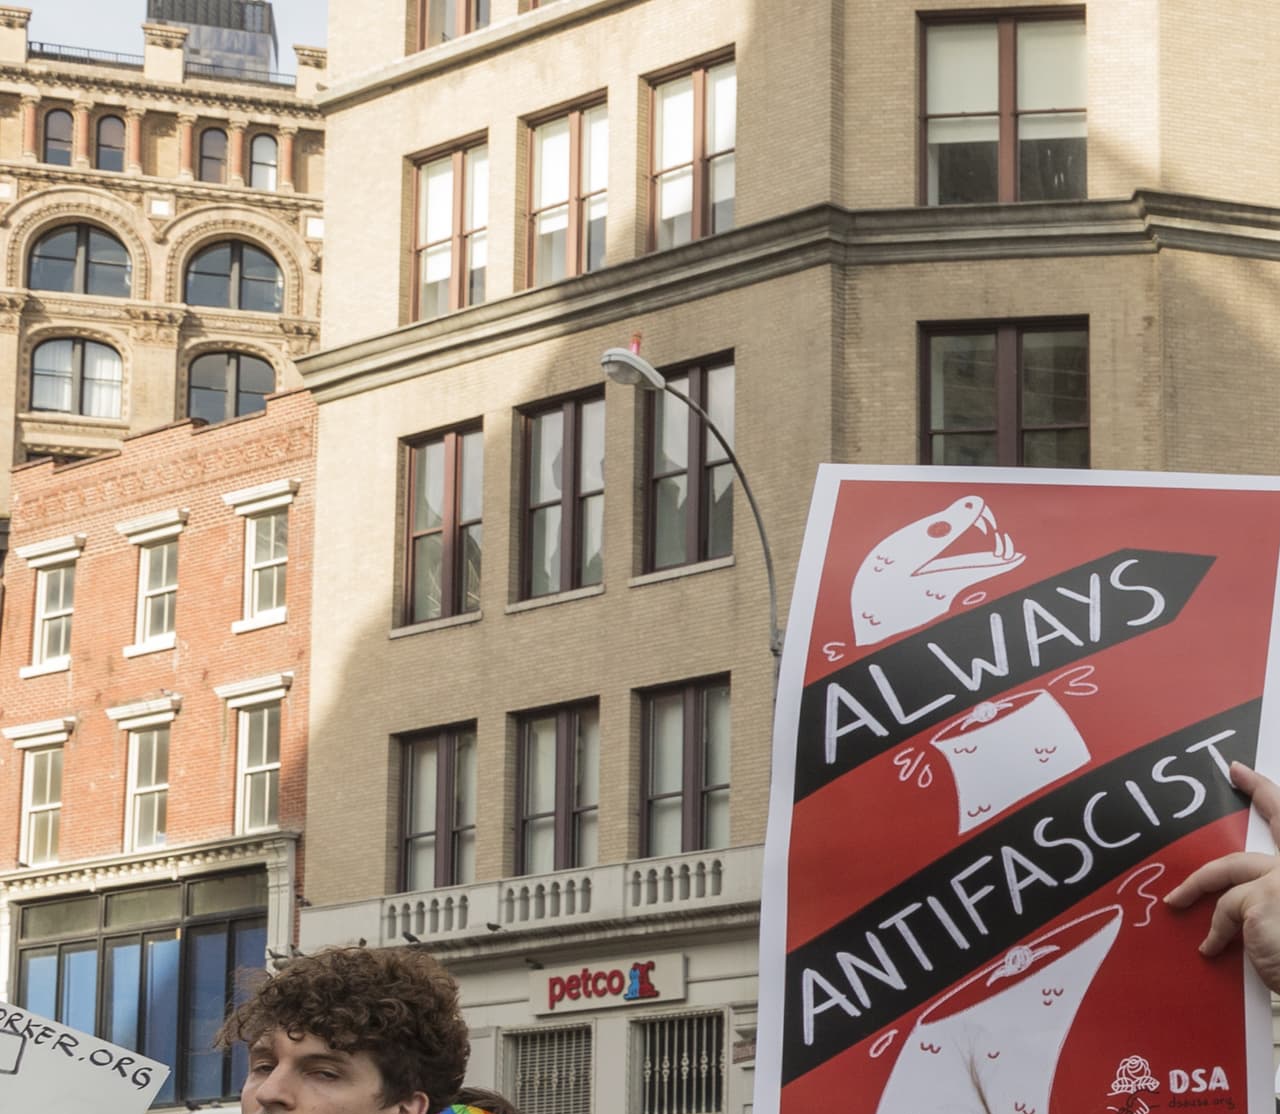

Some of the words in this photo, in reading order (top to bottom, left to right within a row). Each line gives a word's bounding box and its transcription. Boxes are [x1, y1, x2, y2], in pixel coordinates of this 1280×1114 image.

[825, 558, 1166, 764] ALWAYS
[803, 729, 1238, 1046] ANTIFASCIST
[549, 968, 625, 1009] petco
[1169, 1066, 1230, 1094] DSA
